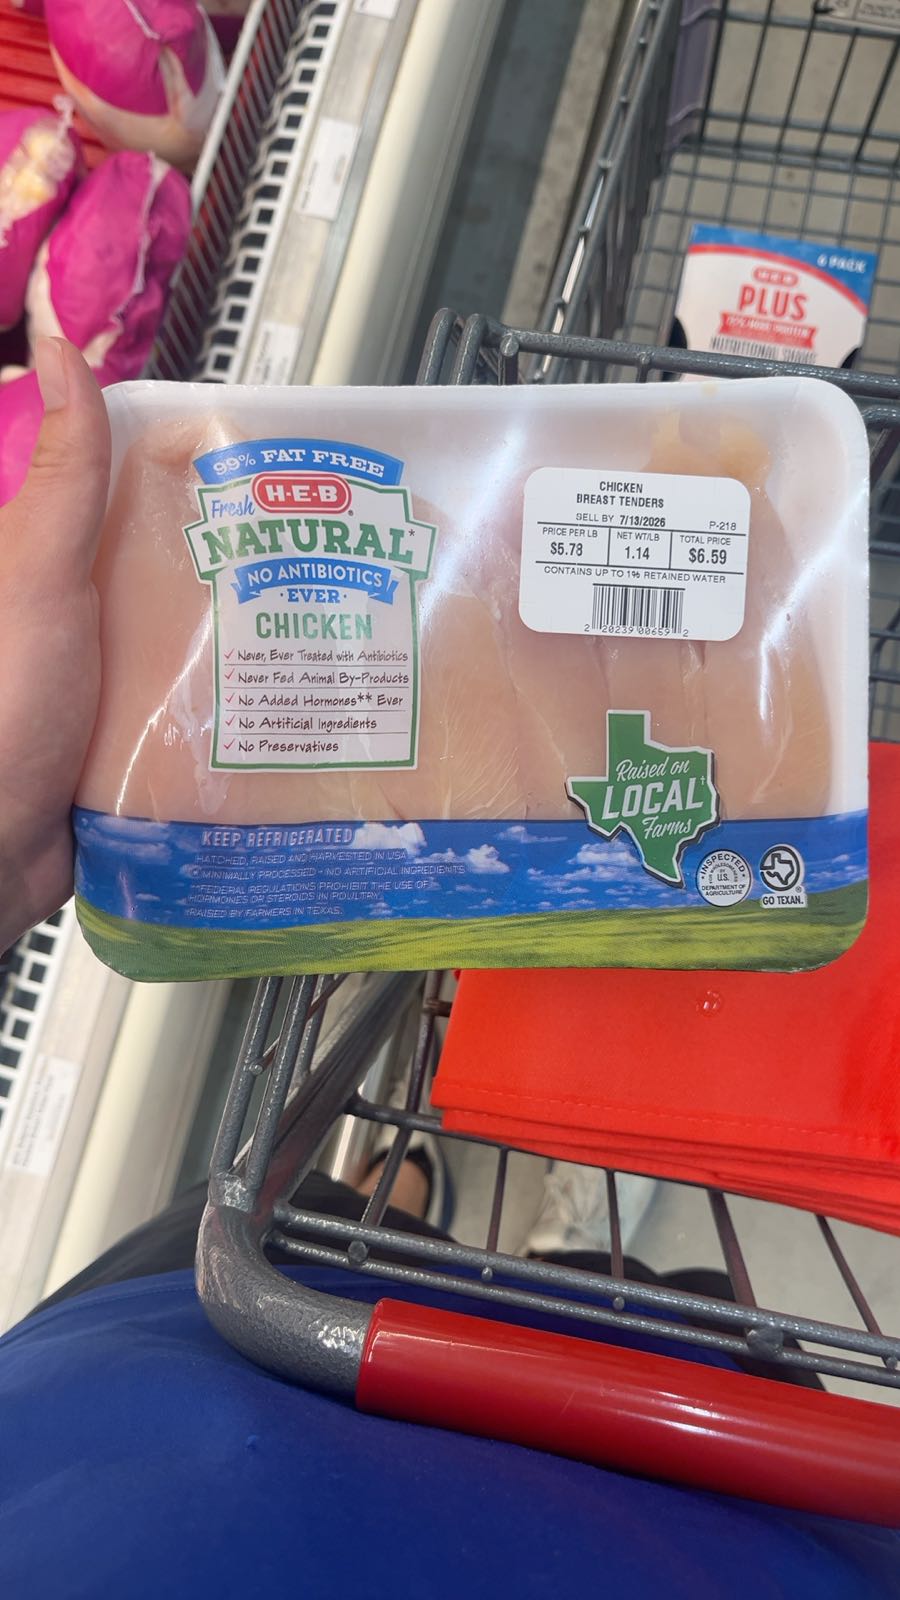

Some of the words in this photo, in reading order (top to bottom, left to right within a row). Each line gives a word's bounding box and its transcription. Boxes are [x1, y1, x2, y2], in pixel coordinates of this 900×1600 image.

[738, 283, 808, 320] PLUS
[213, 453, 256, 476] 99%
[260, 449, 306, 464] FAT
[312, 449, 385, 478] FREE
[265, 484, 338, 503] H-E-B
[599, 481, 643, 494] CHICKEN
[211, 495, 255, 519] Fresh
[576, 493, 615, 506] BREAST
[619, 496, 665, 509] TENDERS
[575, 512, 599, 523] SELL
[601, 514, 614, 524] BY
[619, 515, 666, 528] 7/13/2026
[709, 521, 737, 532] P-218
[542, 527, 567, 537] PRICE
[569, 528, 586, 538] PER
[587, 529, 598, 538] LB
[617, 531, 633, 540] NET
[634, 532, 660, 542] WT/LB
[680, 535, 705, 545] TOTAL
[706, 537, 731, 546] PRICE
[624, 546, 650, 560] 1.14
[688, 548, 728, 565] $6.59
[247, 566, 273, 588] NO
[277, 563, 383, 588] ANTIBIOTICS
[544, 566, 592, 577] CONTAINS
[595, 568, 609, 577] UP
[611, 569, 624, 578] TO
[643, 571, 690, 582] RETAINED
[692, 574, 726, 584] WATER
[287, 588, 341, 604] EVER
[256, 612, 373, 640] CHICKEN
[584, 624, 590, 632] 2
[683, 629, 689, 637] 2
[237, 650, 267, 663] Never,
[269, 650, 294, 661] Ever
[297, 650, 333, 662] Treated
[336, 650, 354, 662] with
[357, 650, 408, 662] Antibiotics
[238, 672, 269, 684] Never
[273, 671, 294, 684] Fed
[299, 672, 335, 684] Animal
[339, 672, 409, 686] By-Products
[238, 695, 254, 706] No
[258, 694, 298, 706] Added
[377, 694, 403, 706] Ever
[238, 717, 255, 729] No
[259, 717, 313, 730] Artificial
[318, 718, 377, 733] Ingredients
[238, 741, 255, 752] No
[259, 740, 339, 752] Preservatives
[616, 756, 669, 782] Raised
[670, 760, 690, 775] on
[642, 816, 692, 839] Farms
[202, 831, 242, 847] KEEP
[247, 828, 352, 847] REFRIGERATED
[251, 854, 286, 865] RAISED
[288, 853, 307, 863] AND
[309, 851, 372, 862] HARVESTED
[375, 851, 385, 860] IN
[700, 853, 746, 875] INSPECTED
[258, 867, 317, 879] PROCESSED
[327, 867, 341, 876] NO
[344, 866, 398, 876] ARTIFICIAL
[717, 873, 730, 882] U.S.
[248, 881, 316, 894] REGULATIONS
[320, 882, 368, 891] PROHIBIT
[371, 881, 391, 890] THE
[394, 880, 414, 890] USE
[415, 880, 430, 889] OF
[188, 894, 248, 905] HORMONES
[251, 894, 265, 903] OR
[267, 892, 315, 903] STEROIDS
[318, 892, 328, 900] IN
[763, 896, 775, 905] GO
[229, 908, 244, 918] BY
[245, 907, 292, 917] FARMERS
[293, 907, 304, 915] IN
